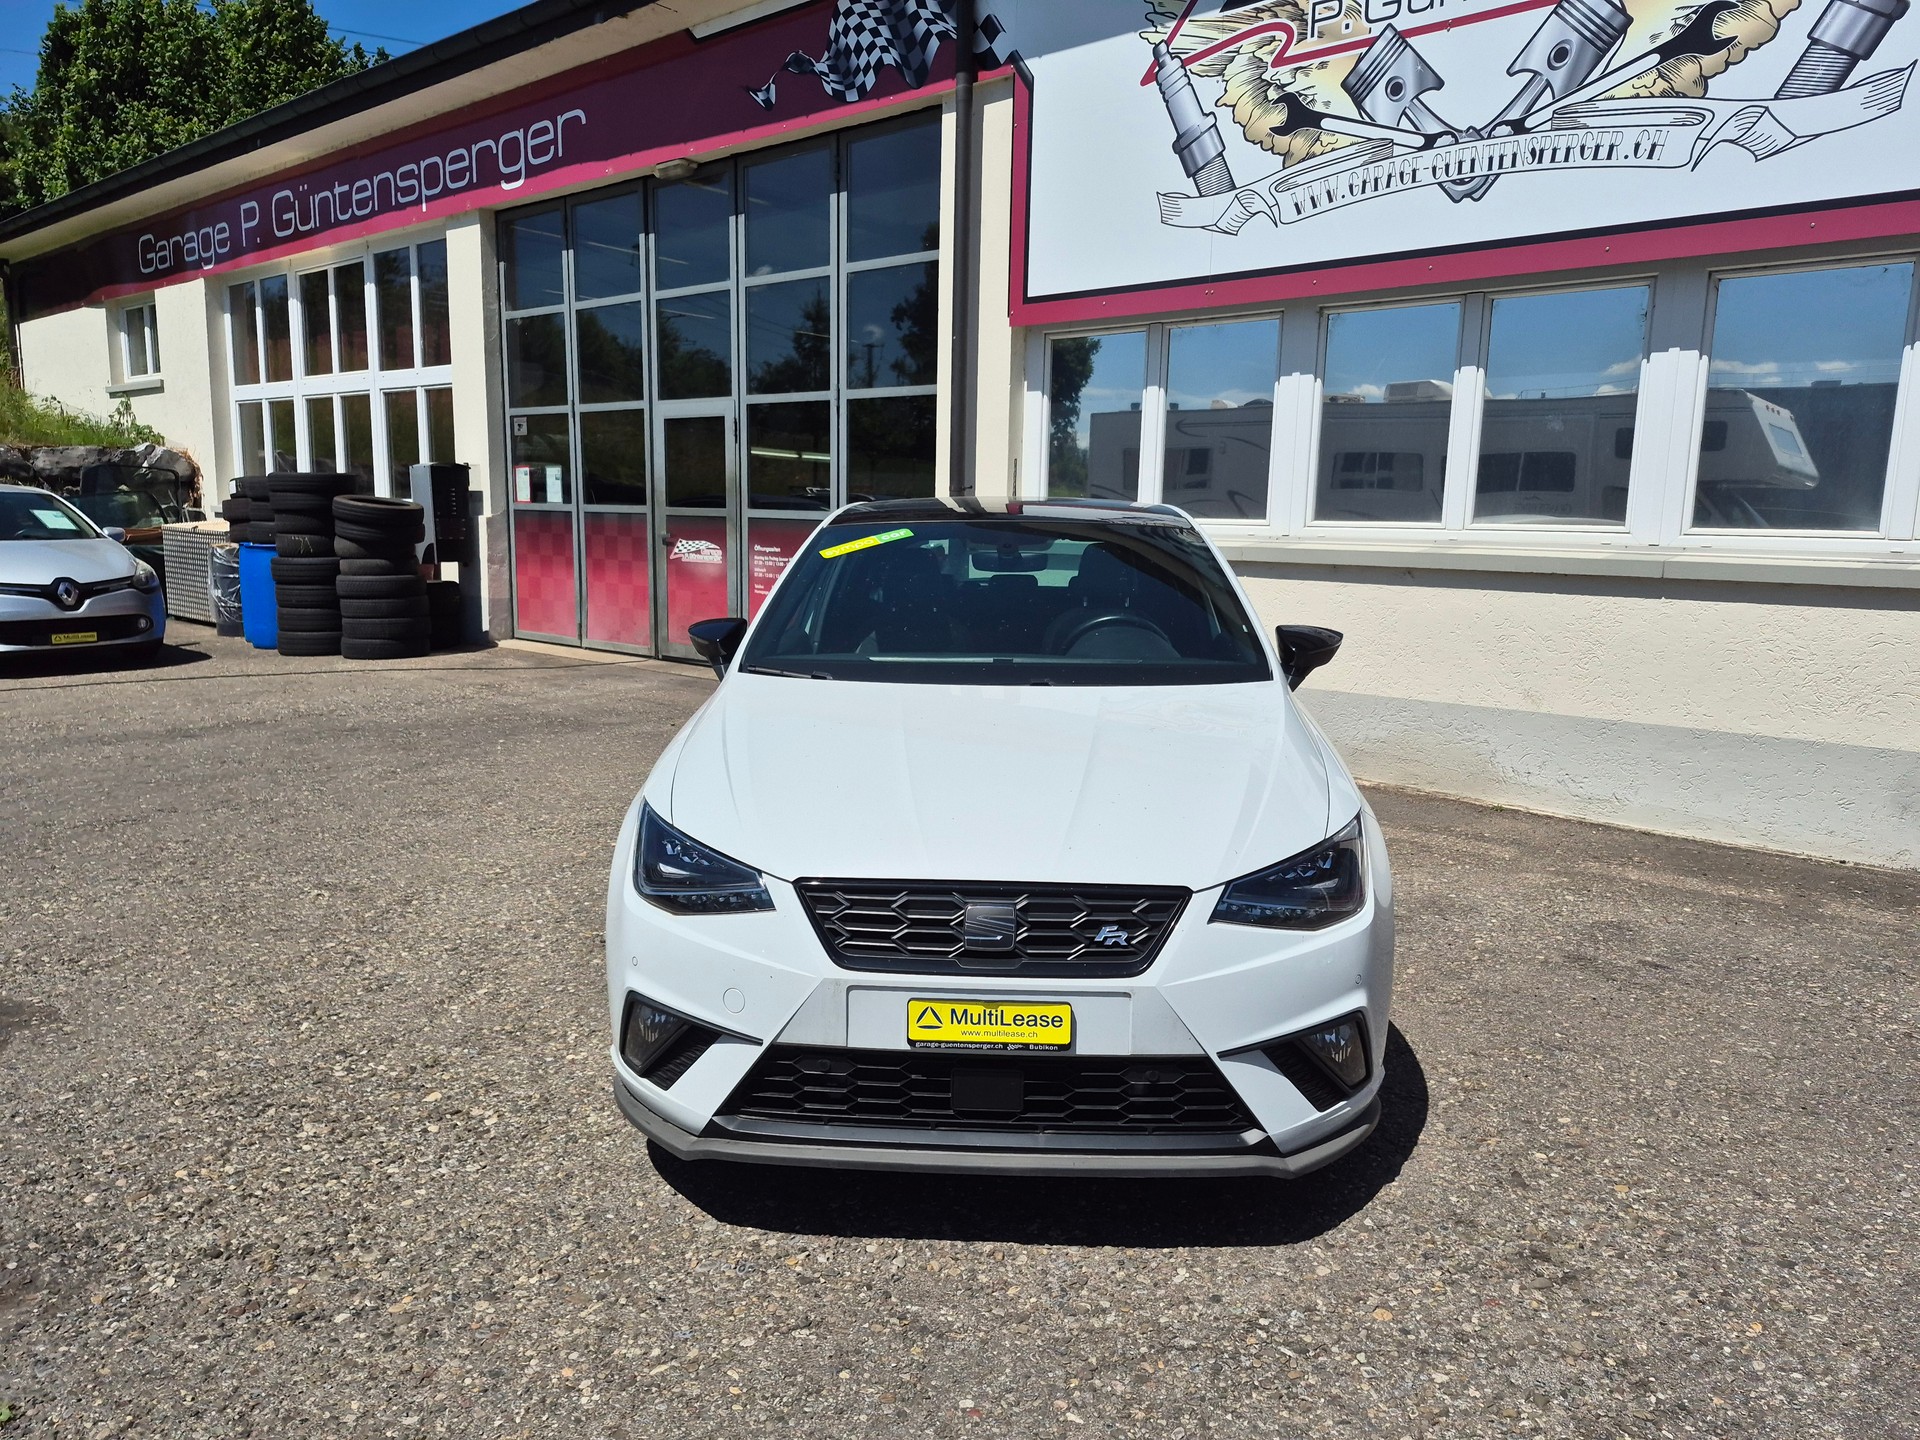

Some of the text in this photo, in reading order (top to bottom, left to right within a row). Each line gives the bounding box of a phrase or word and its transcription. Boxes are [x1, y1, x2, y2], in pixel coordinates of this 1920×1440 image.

[1290, 128, 1671, 217] WWW.GARAGE-GUENTENSPERGER.CH
[138, 108, 587, 274] Garage P. Güntensperger
[881, 530, 907, 541] car
[1094, 925, 1129, 946] FR
[950, 1008, 1064, 1028] MultiLease
[960, 1029, 1038, 1039] www.multilease.ch
[915, 1041, 1004, 1050] garage-guentensperger.ch
